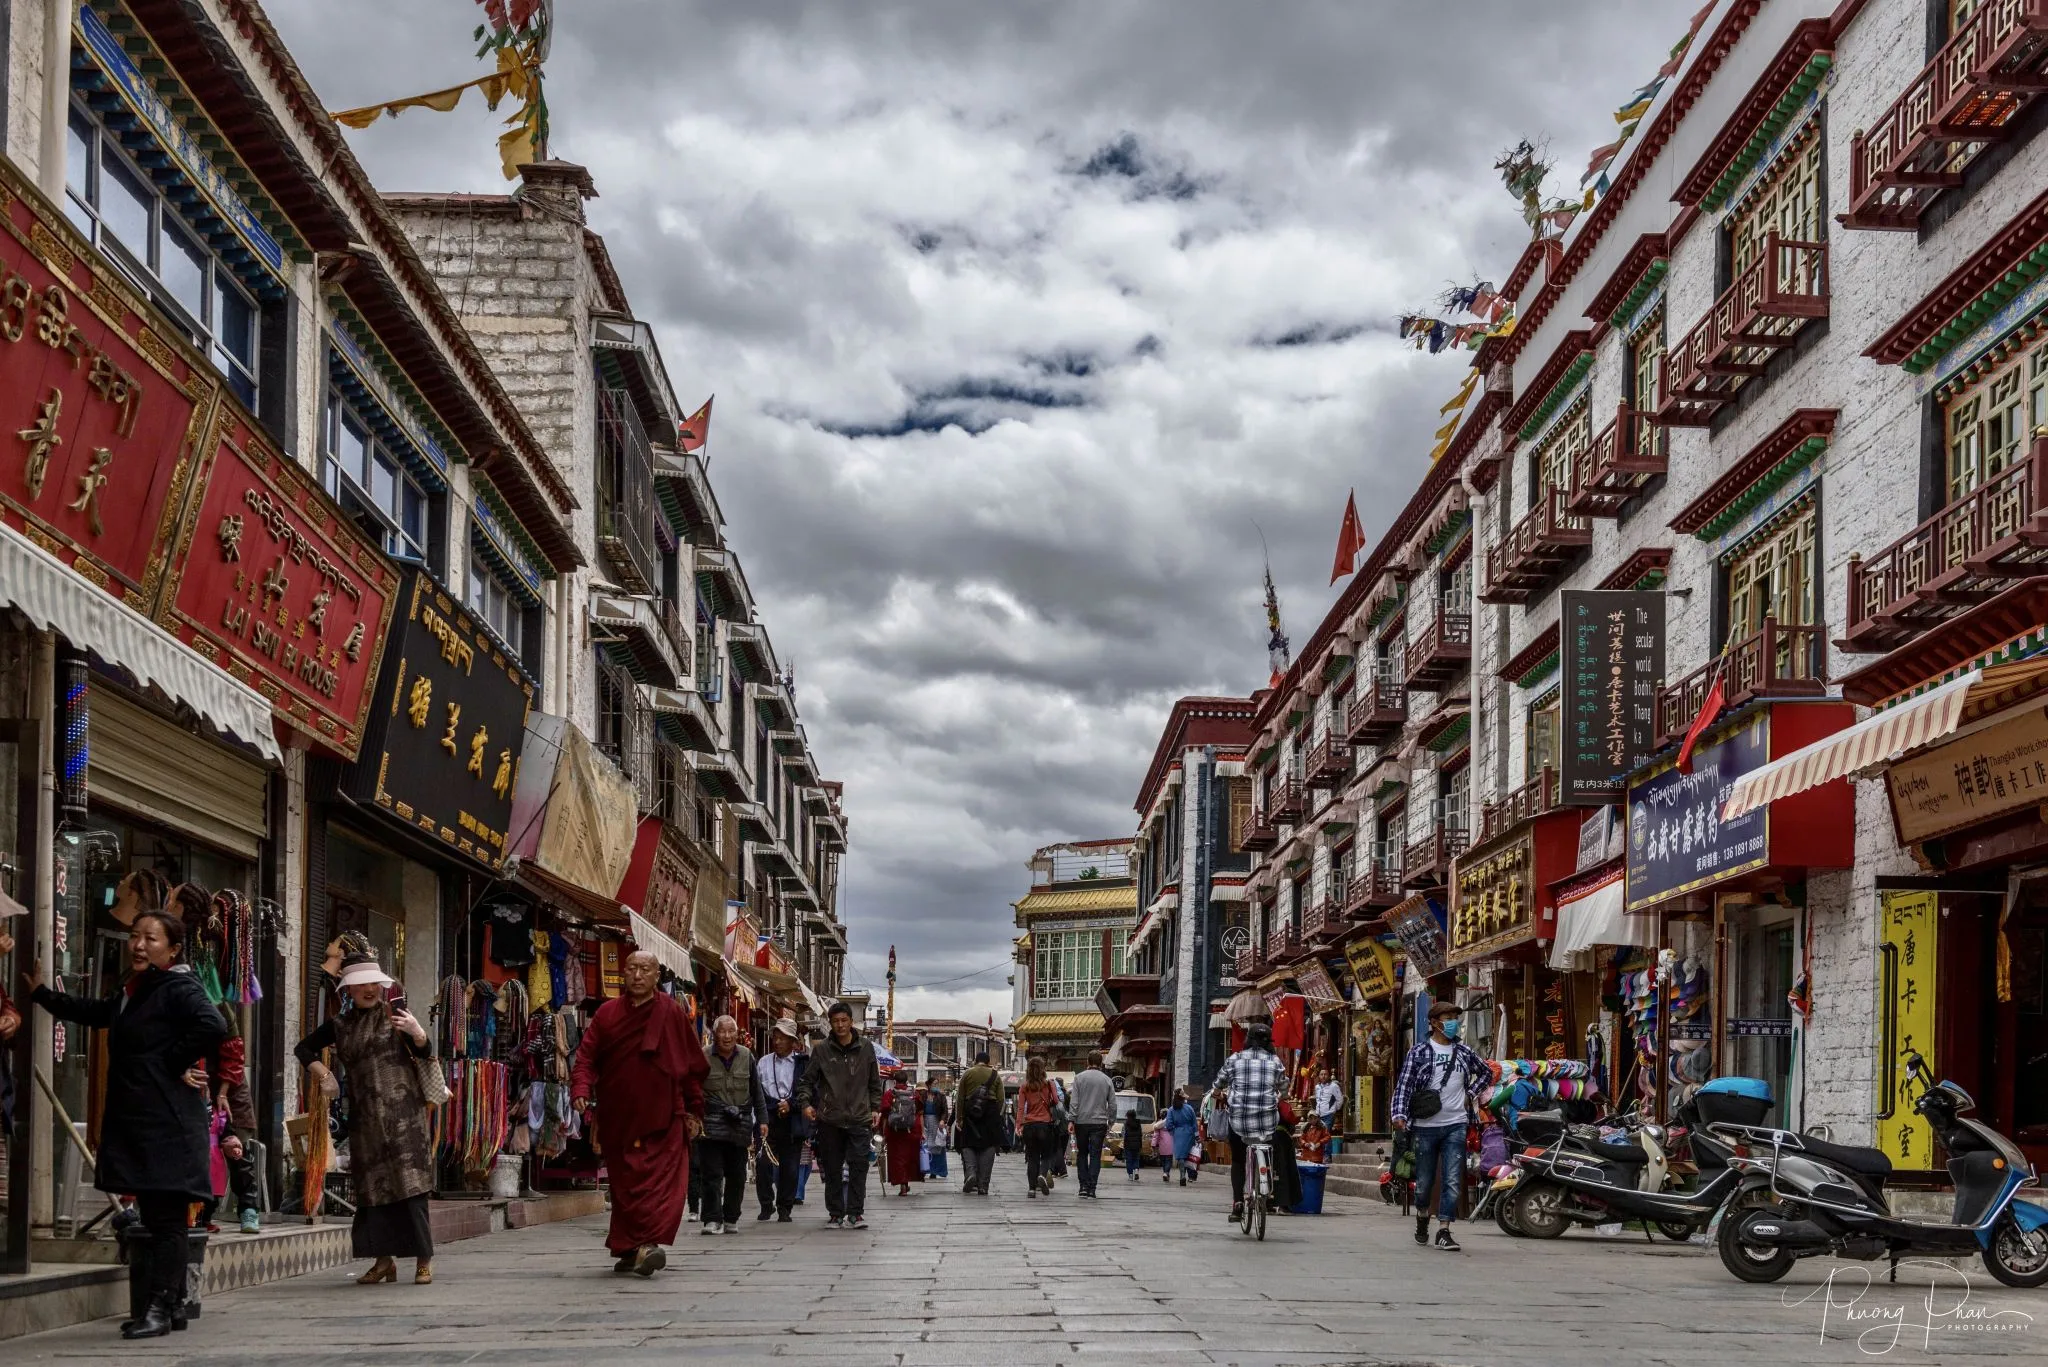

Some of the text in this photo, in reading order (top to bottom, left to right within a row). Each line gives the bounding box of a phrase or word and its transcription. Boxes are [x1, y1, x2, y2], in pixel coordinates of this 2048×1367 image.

[1636, 607, 1648, 624] The
[222, 597, 340, 699] LAI SAN FA HOUSE
[1635, 631, 1654, 648] secular
[1635, 656, 1652, 672] world
[1633, 703, 1651, 724] Thang
[1897, 928, 1920, 1158] 唐卡工作室
